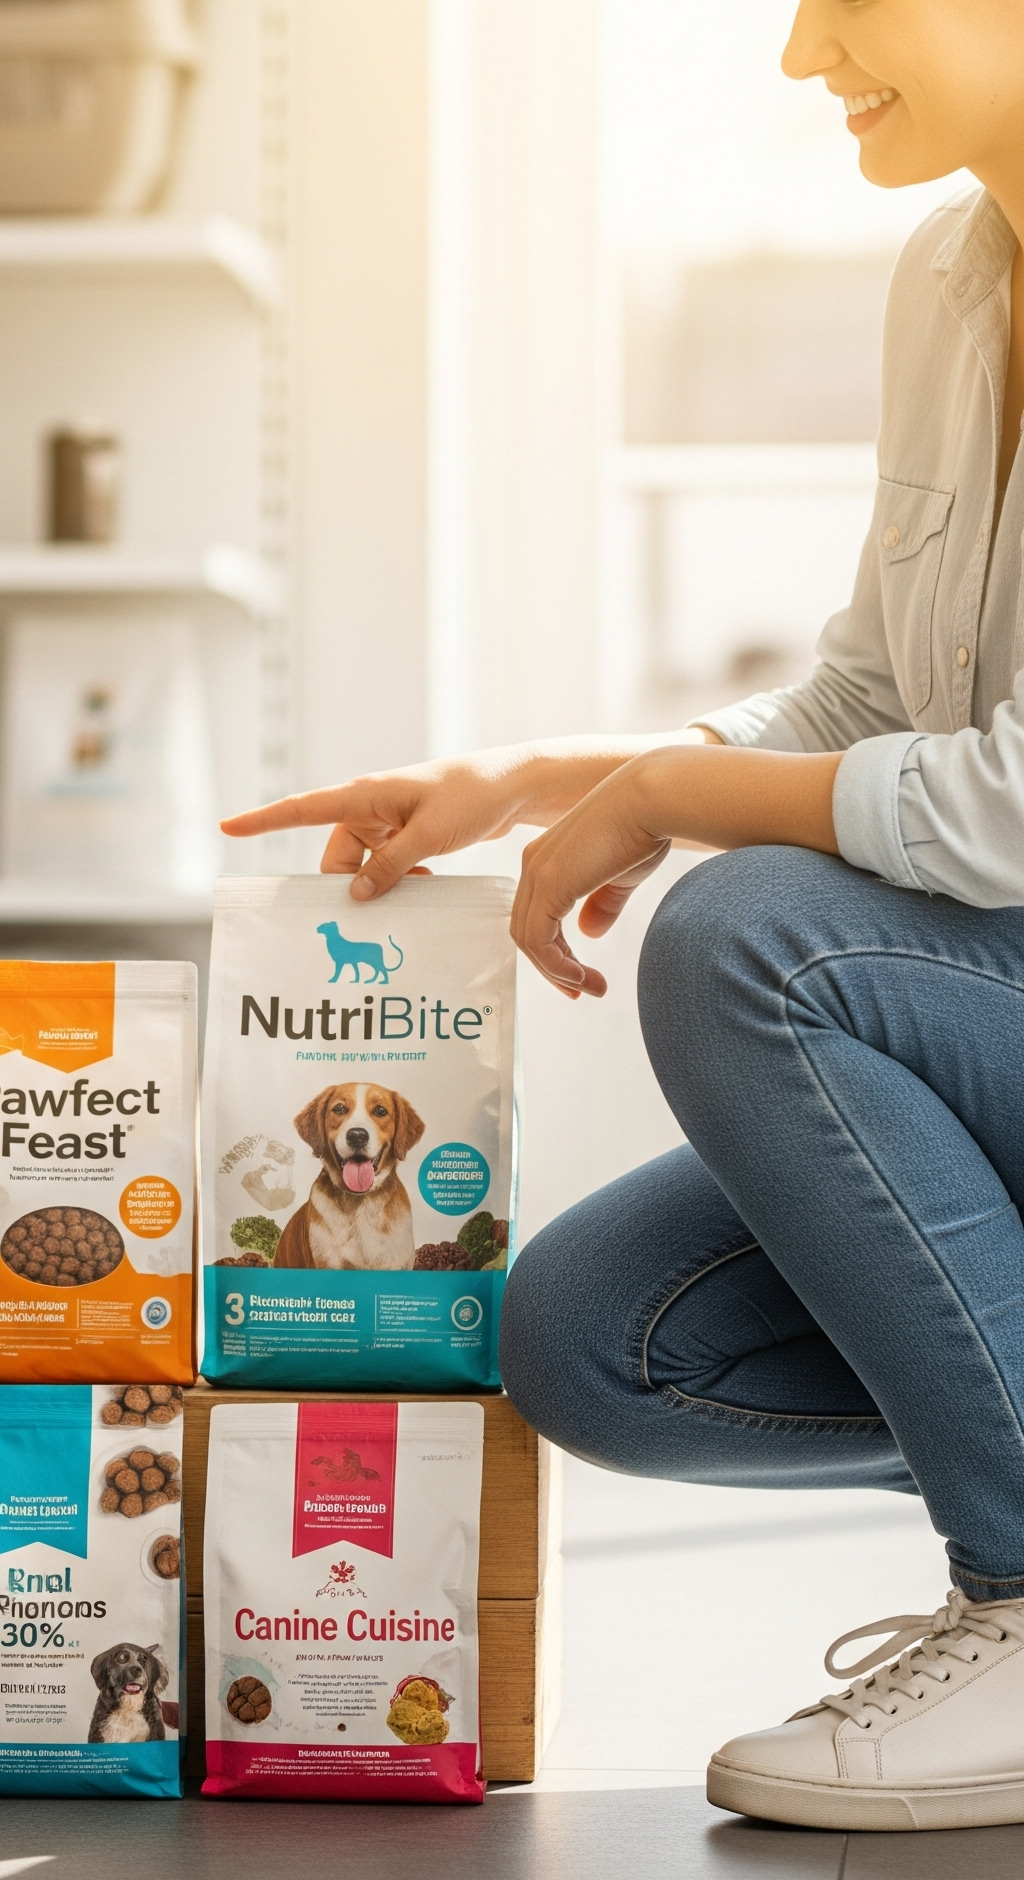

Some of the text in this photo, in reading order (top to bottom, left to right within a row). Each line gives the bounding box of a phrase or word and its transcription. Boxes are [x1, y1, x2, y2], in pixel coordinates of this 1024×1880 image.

[241, 995, 483, 1040] NutriBite
[2, 1121, 126, 1159] Feast
[225, 1293, 245, 1325] 3
[1, 1621, 65, 1647] 30%
[235, 1608, 455, 1641] Canine Cuisine
